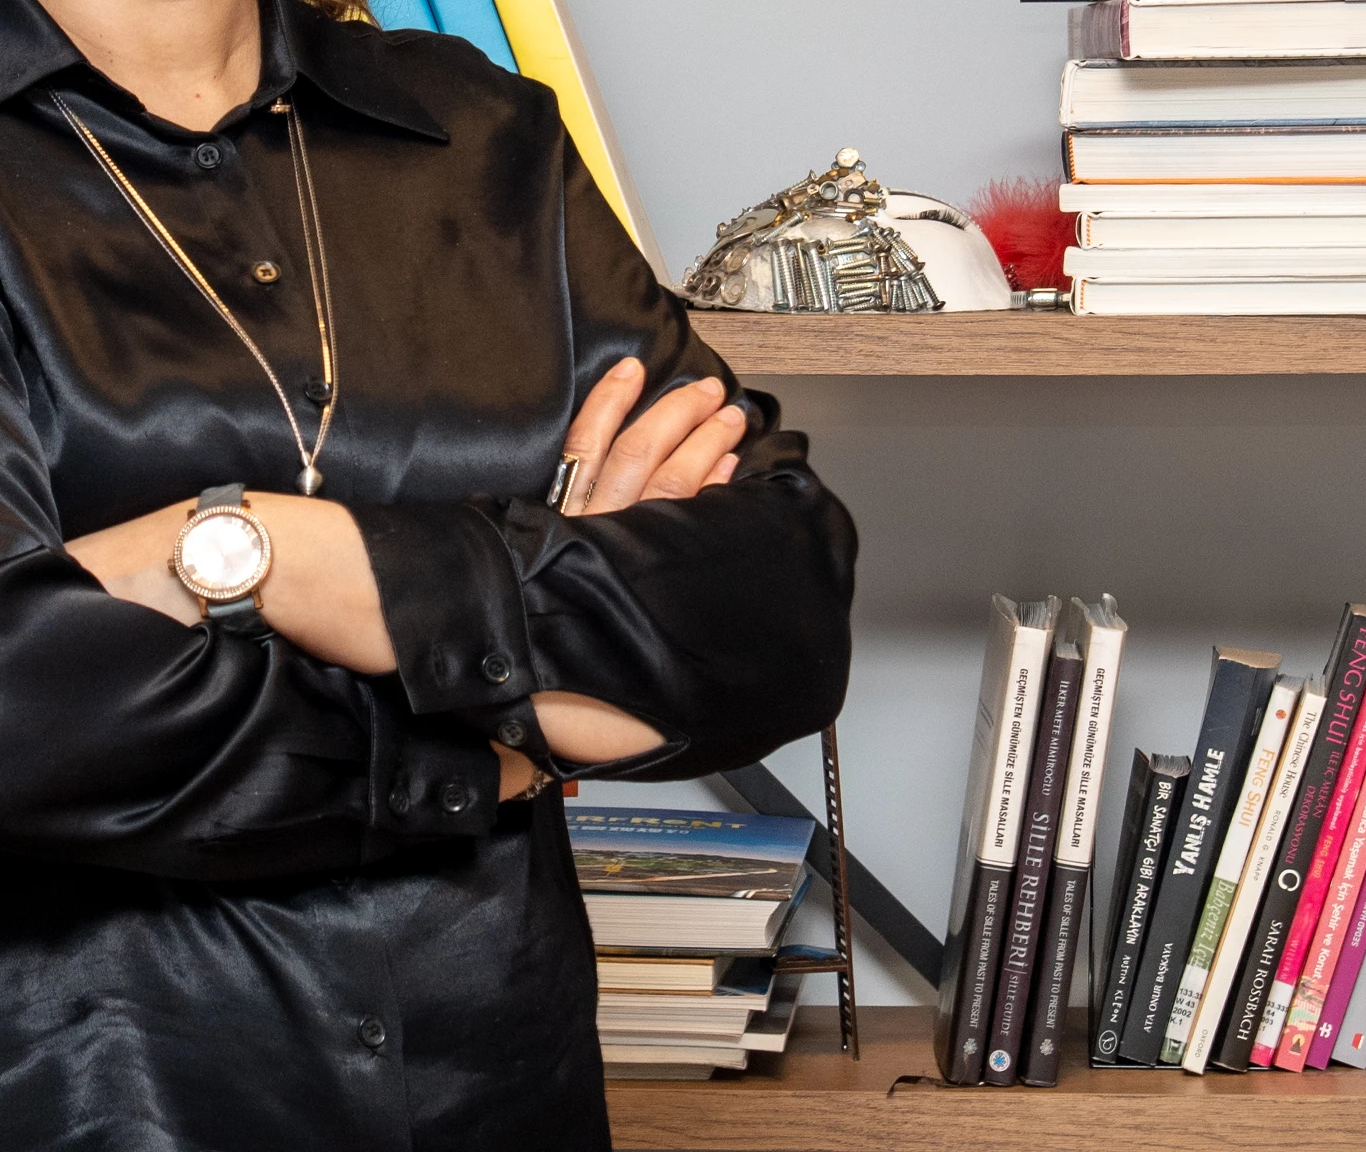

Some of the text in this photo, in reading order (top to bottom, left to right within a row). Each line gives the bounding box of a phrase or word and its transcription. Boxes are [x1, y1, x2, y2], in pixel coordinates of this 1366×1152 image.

[994, 667, 1028, 848] GEÇMİŞTEN GÜNÜMÜZE SİLLE MASALLARI
[1279, 711, 1317, 798] The Chinese House
[1155, 780, 1172, 800] BİR
[1238, 747, 1276, 827] FENG SHUI
[1143, 804, 1167, 852] SANATÇI
[1172, 747, 1225, 875] YANLIŞ HAMLE
[1342, 837, 1365, 880] Yaşamak
[1008, 811, 1050, 967] SİLLE REHBERİ
[1336, 881, 1353, 901] İçin
[1327, 902, 1344, 931] Şehir
[1321, 931, 1333, 946] ve
[1118, 954, 1131, 984] AUSTIN
[1236, 919, 1282, 1040] SARAH ROSSBACH
[1307, 947, 1330, 981] Konut
[1000, 1001, 1014, 1036] GUIDE
[1172, 1007, 1192, 1018] 2002
